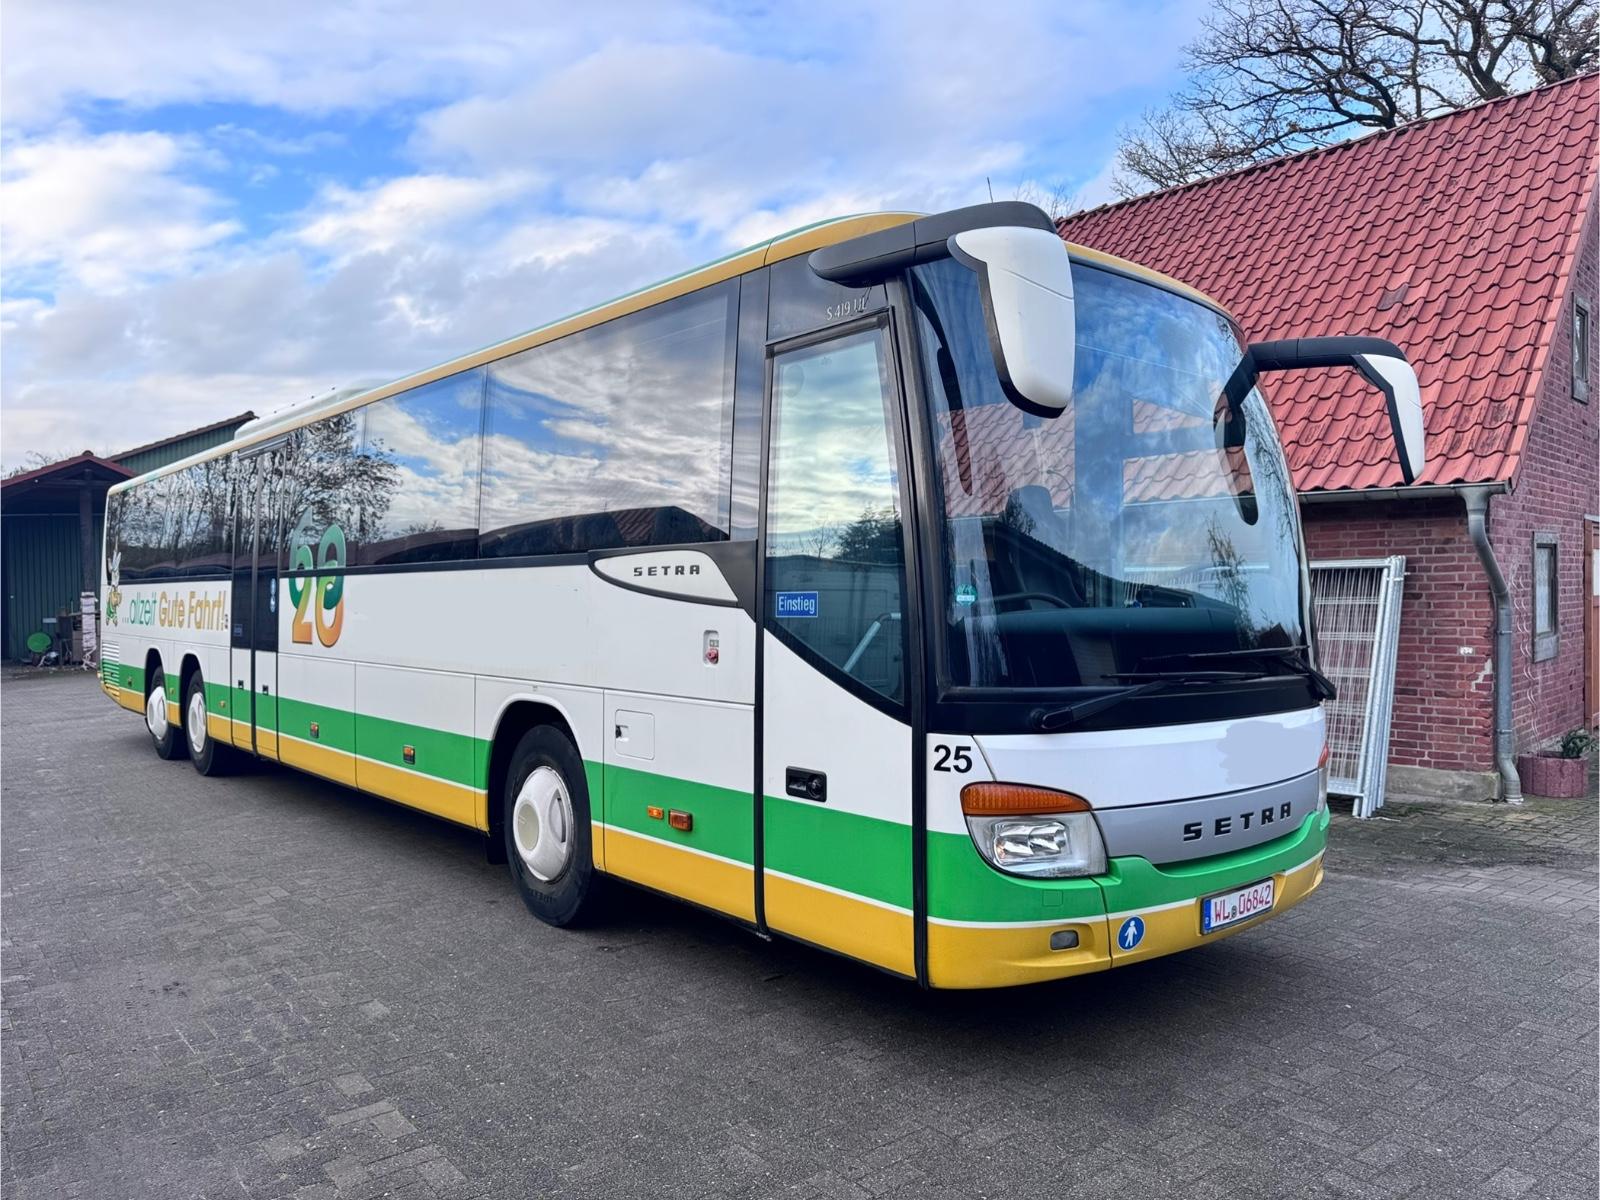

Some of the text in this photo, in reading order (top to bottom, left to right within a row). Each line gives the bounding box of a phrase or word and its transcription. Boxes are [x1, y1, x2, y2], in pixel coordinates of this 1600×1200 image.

[826, 306, 833, 320] S
[834, 301, 850, 318] 419
[633, 565, 700, 577] SETRA
[159, 591, 185, 628] Gute
[187, 590, 226, 631] Fahrt!
[778, 596, 815, 614] Einstieg
[933, 744, 973, 773] 25
[1183, 801, 1291, 842] SETRA
[1214, 898, 1230, 922] WL
[1238, 884, 1271, 915] 06842
